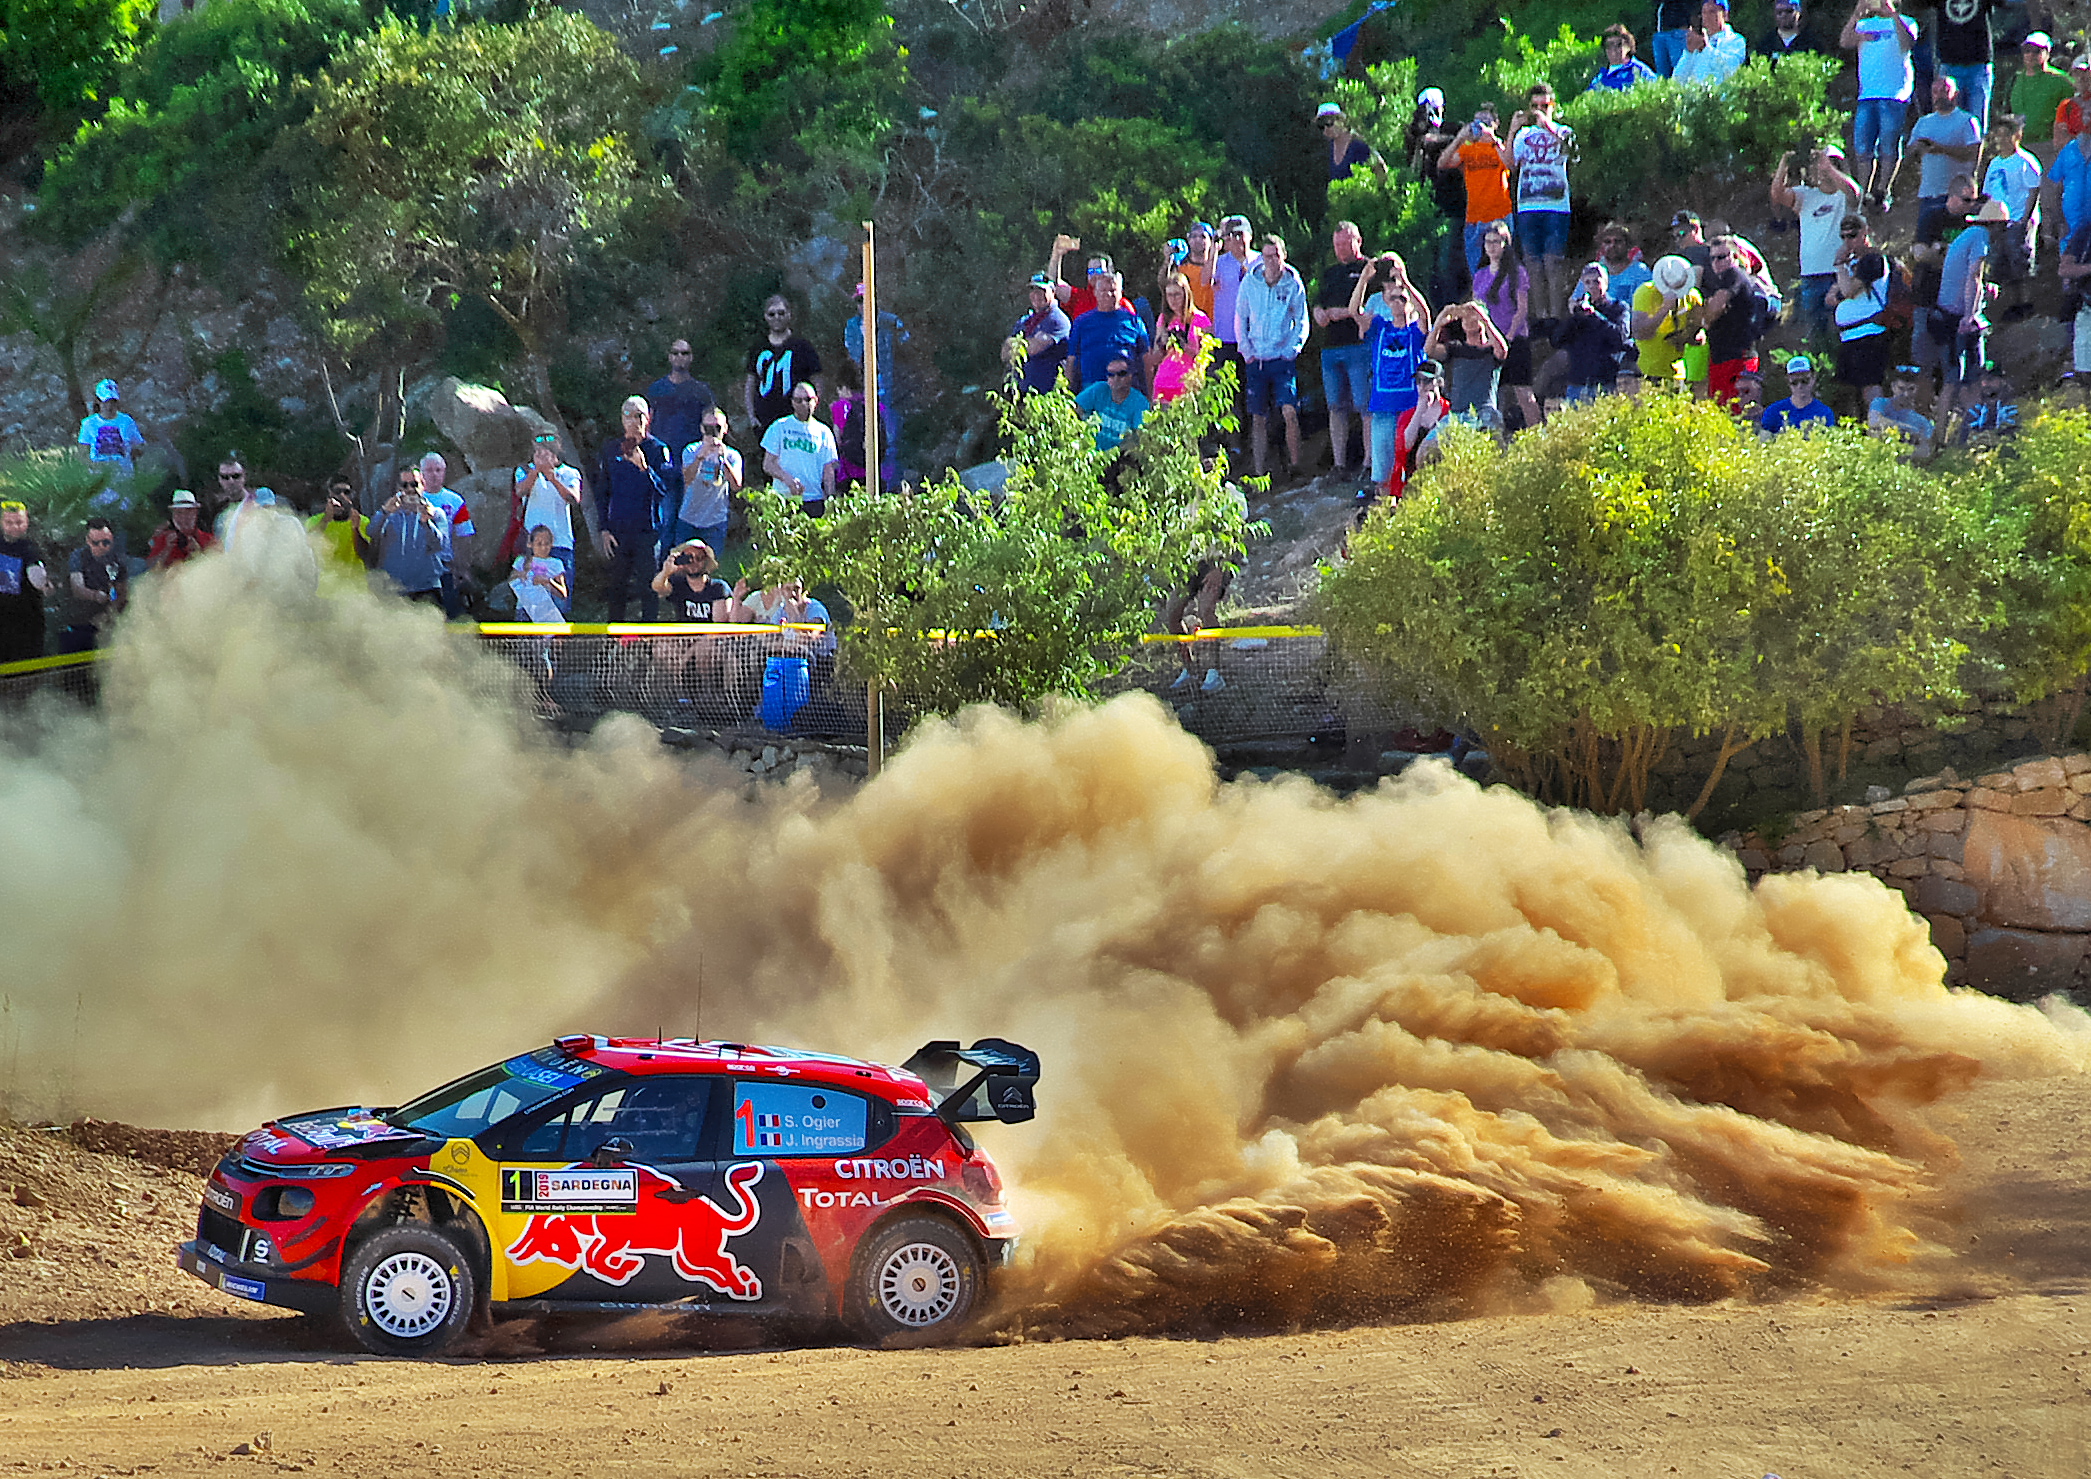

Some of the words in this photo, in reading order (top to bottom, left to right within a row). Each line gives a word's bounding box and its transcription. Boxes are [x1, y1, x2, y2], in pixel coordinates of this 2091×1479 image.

[736, 1099, 755, 1148] 1
[784, 1115, 799, 1128] S.
[802, 1115, 841, 1131] Ogier
[785, 1133, 799, 1147] J.
[801, 1133, 867, 1150] Ingrassia
[834, 1153, 946, 1179] CITROËN
[509, 1170, 521, 1201] 1
[537, 1173, 550, 1198] 2019
[551, 1179, 632, 1191] SARDEGNA
[797, 1187, 890, 1208] TOTAL
